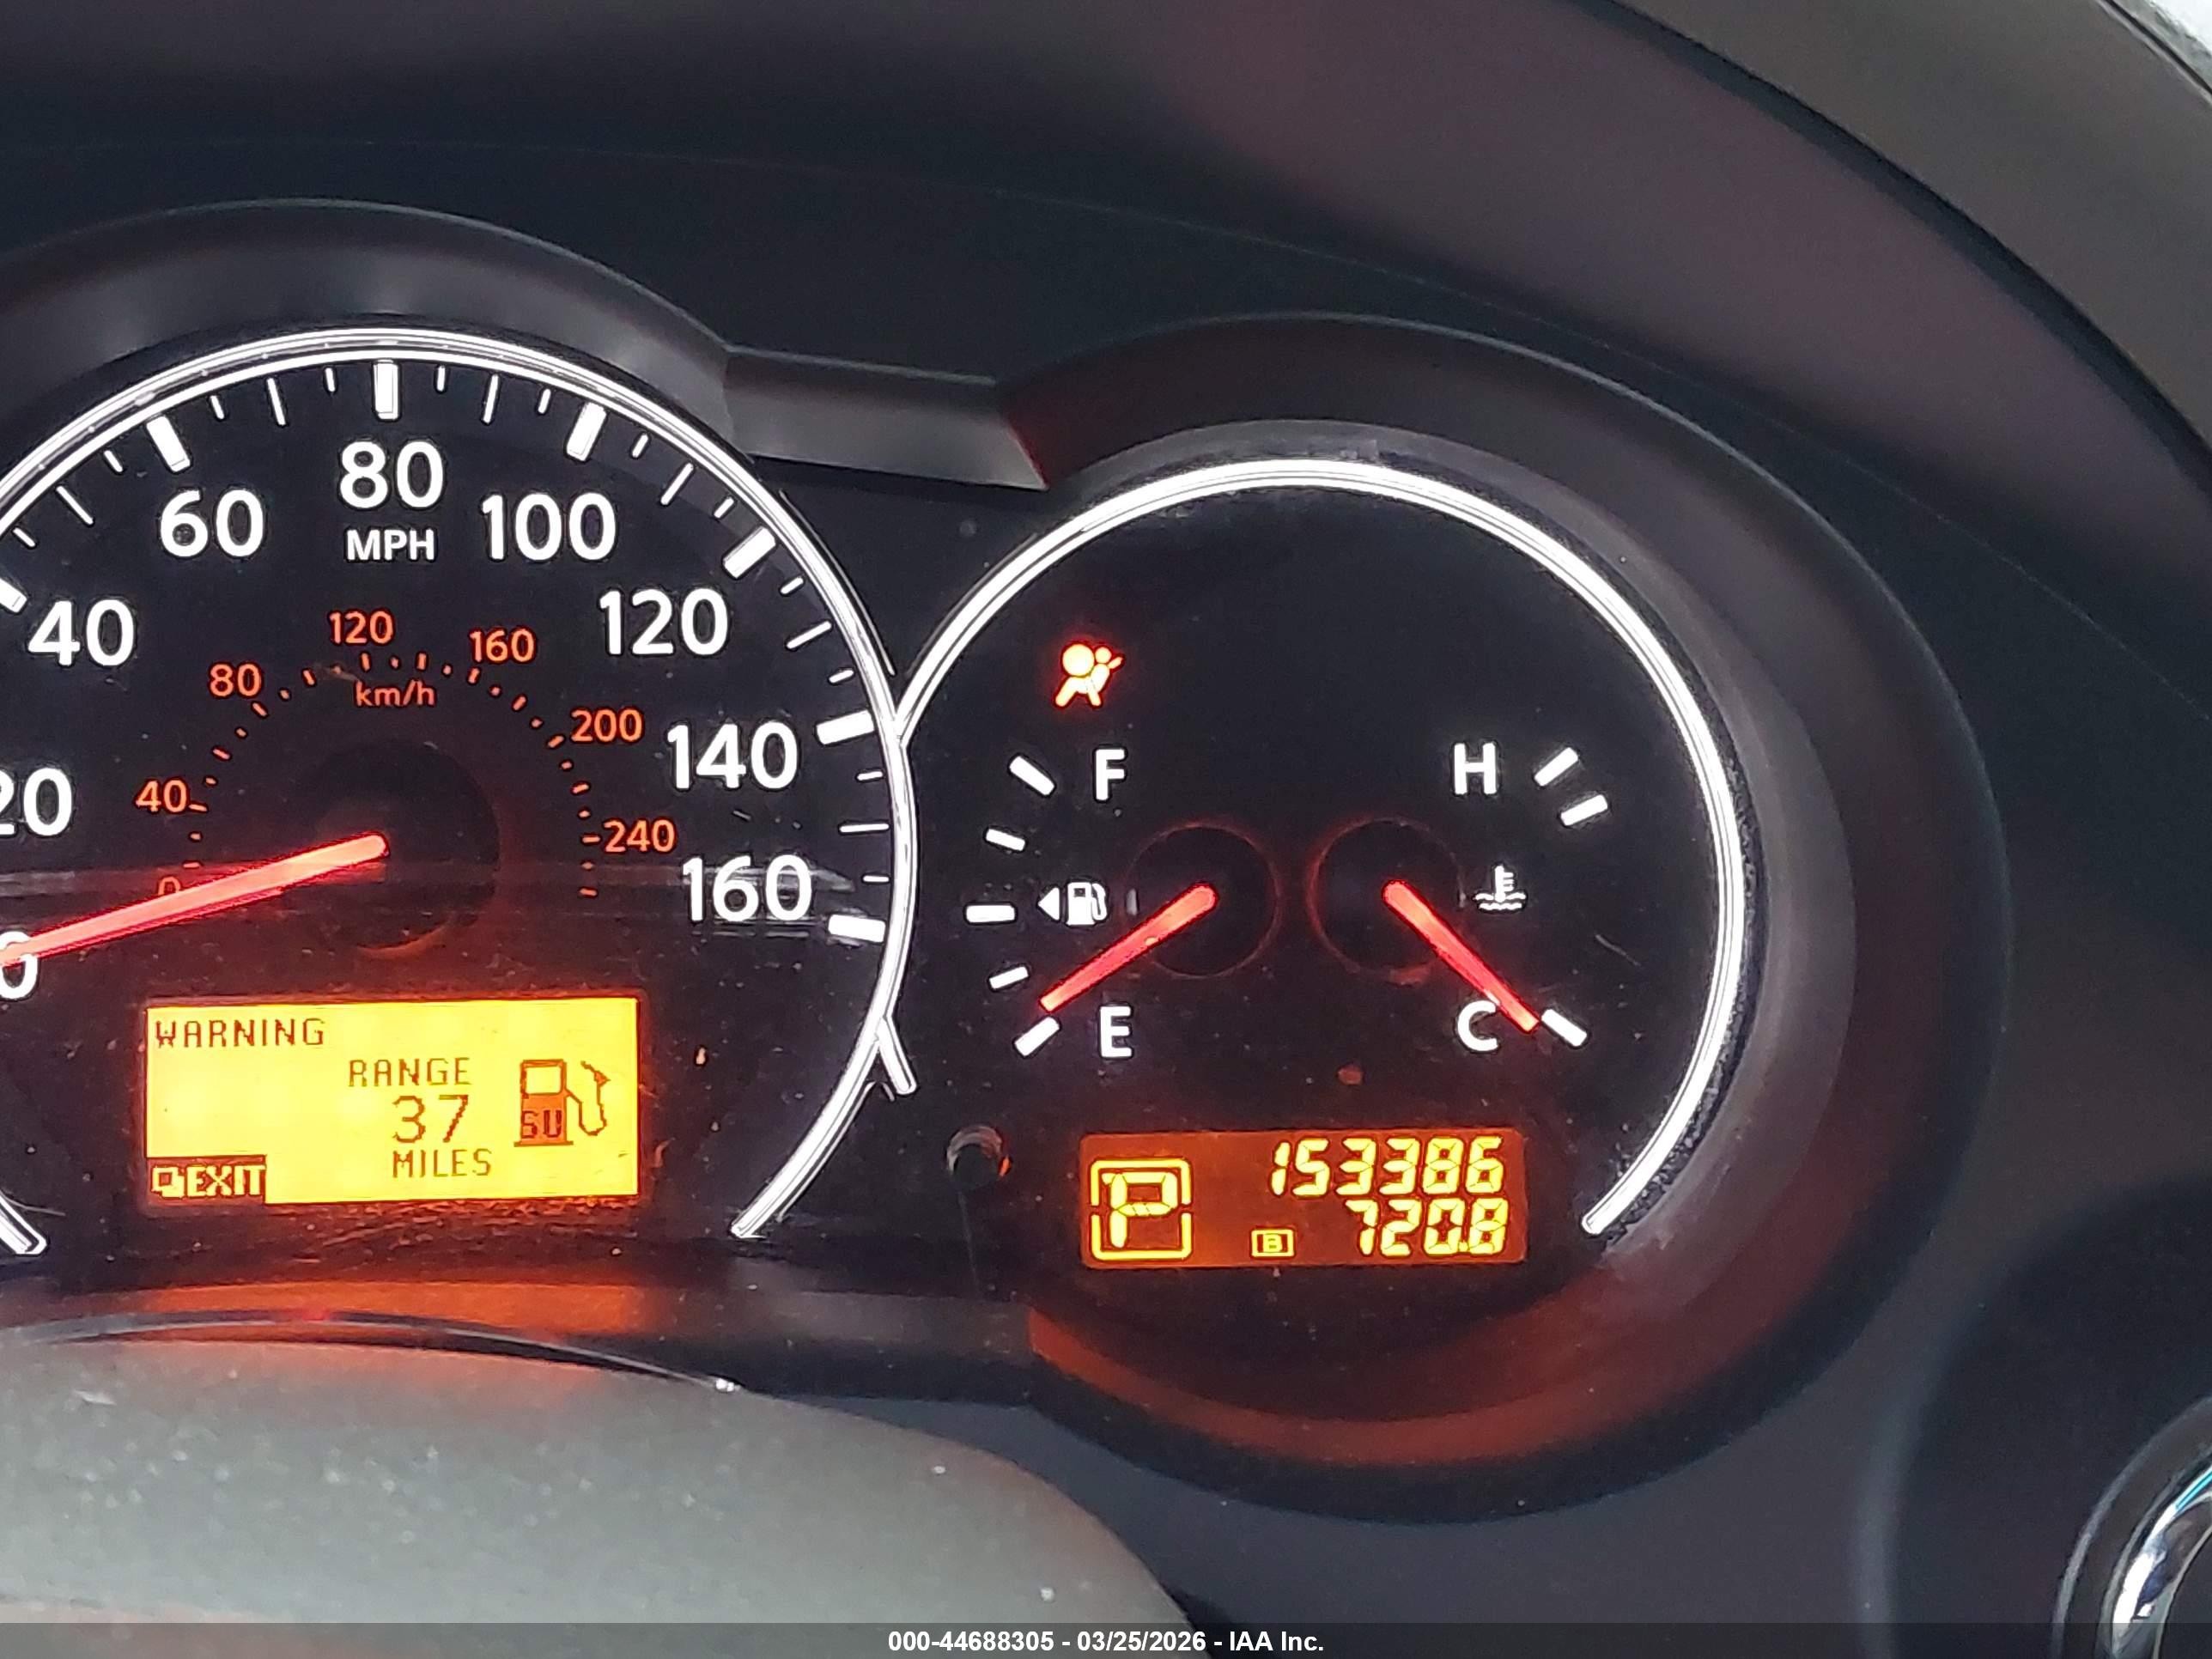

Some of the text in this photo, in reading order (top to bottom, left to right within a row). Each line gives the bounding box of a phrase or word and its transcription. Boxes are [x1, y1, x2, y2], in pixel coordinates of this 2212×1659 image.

[340, 441, 443, 507] 80
[161, 489, 263, 556] 60
[348, 529, 434, 560] MPH
[478, 493, 616, 560] 100
[28, 600, 133, 666] 40
[330, 611, 392, 643] 120
[471, 629, 534, 661] 160
[600, 588, 727, 654] 120
[210, 664, 261, 696] 80
[356, 679, 434, 706] km/h
[572, 709, 641, 741] 200
[668, 721, 797, 788] 140
[1096, 749, 1125, 800] F
[1454, 743, 1498, 794] H
[136, 781, 187, 812] 40
[605, 820, 674, 853] 240
[684, 854, 811, 921] 160
[155, 1018, 325, 1048] WARNING
[1099, 1006, 1132, 1058] E
[1457, 998, 1498, 1051] C
[349, 1057, 471, 1087] RANGE
[392, 1095, 469, 1143] 37
[186, 1165, 265, 1197] EXIT
[392, 1148, 491, 1178] MILES
[1272, 1137, 1504, 1195] 153386
[1102, 1172, 1177, 1248] P
